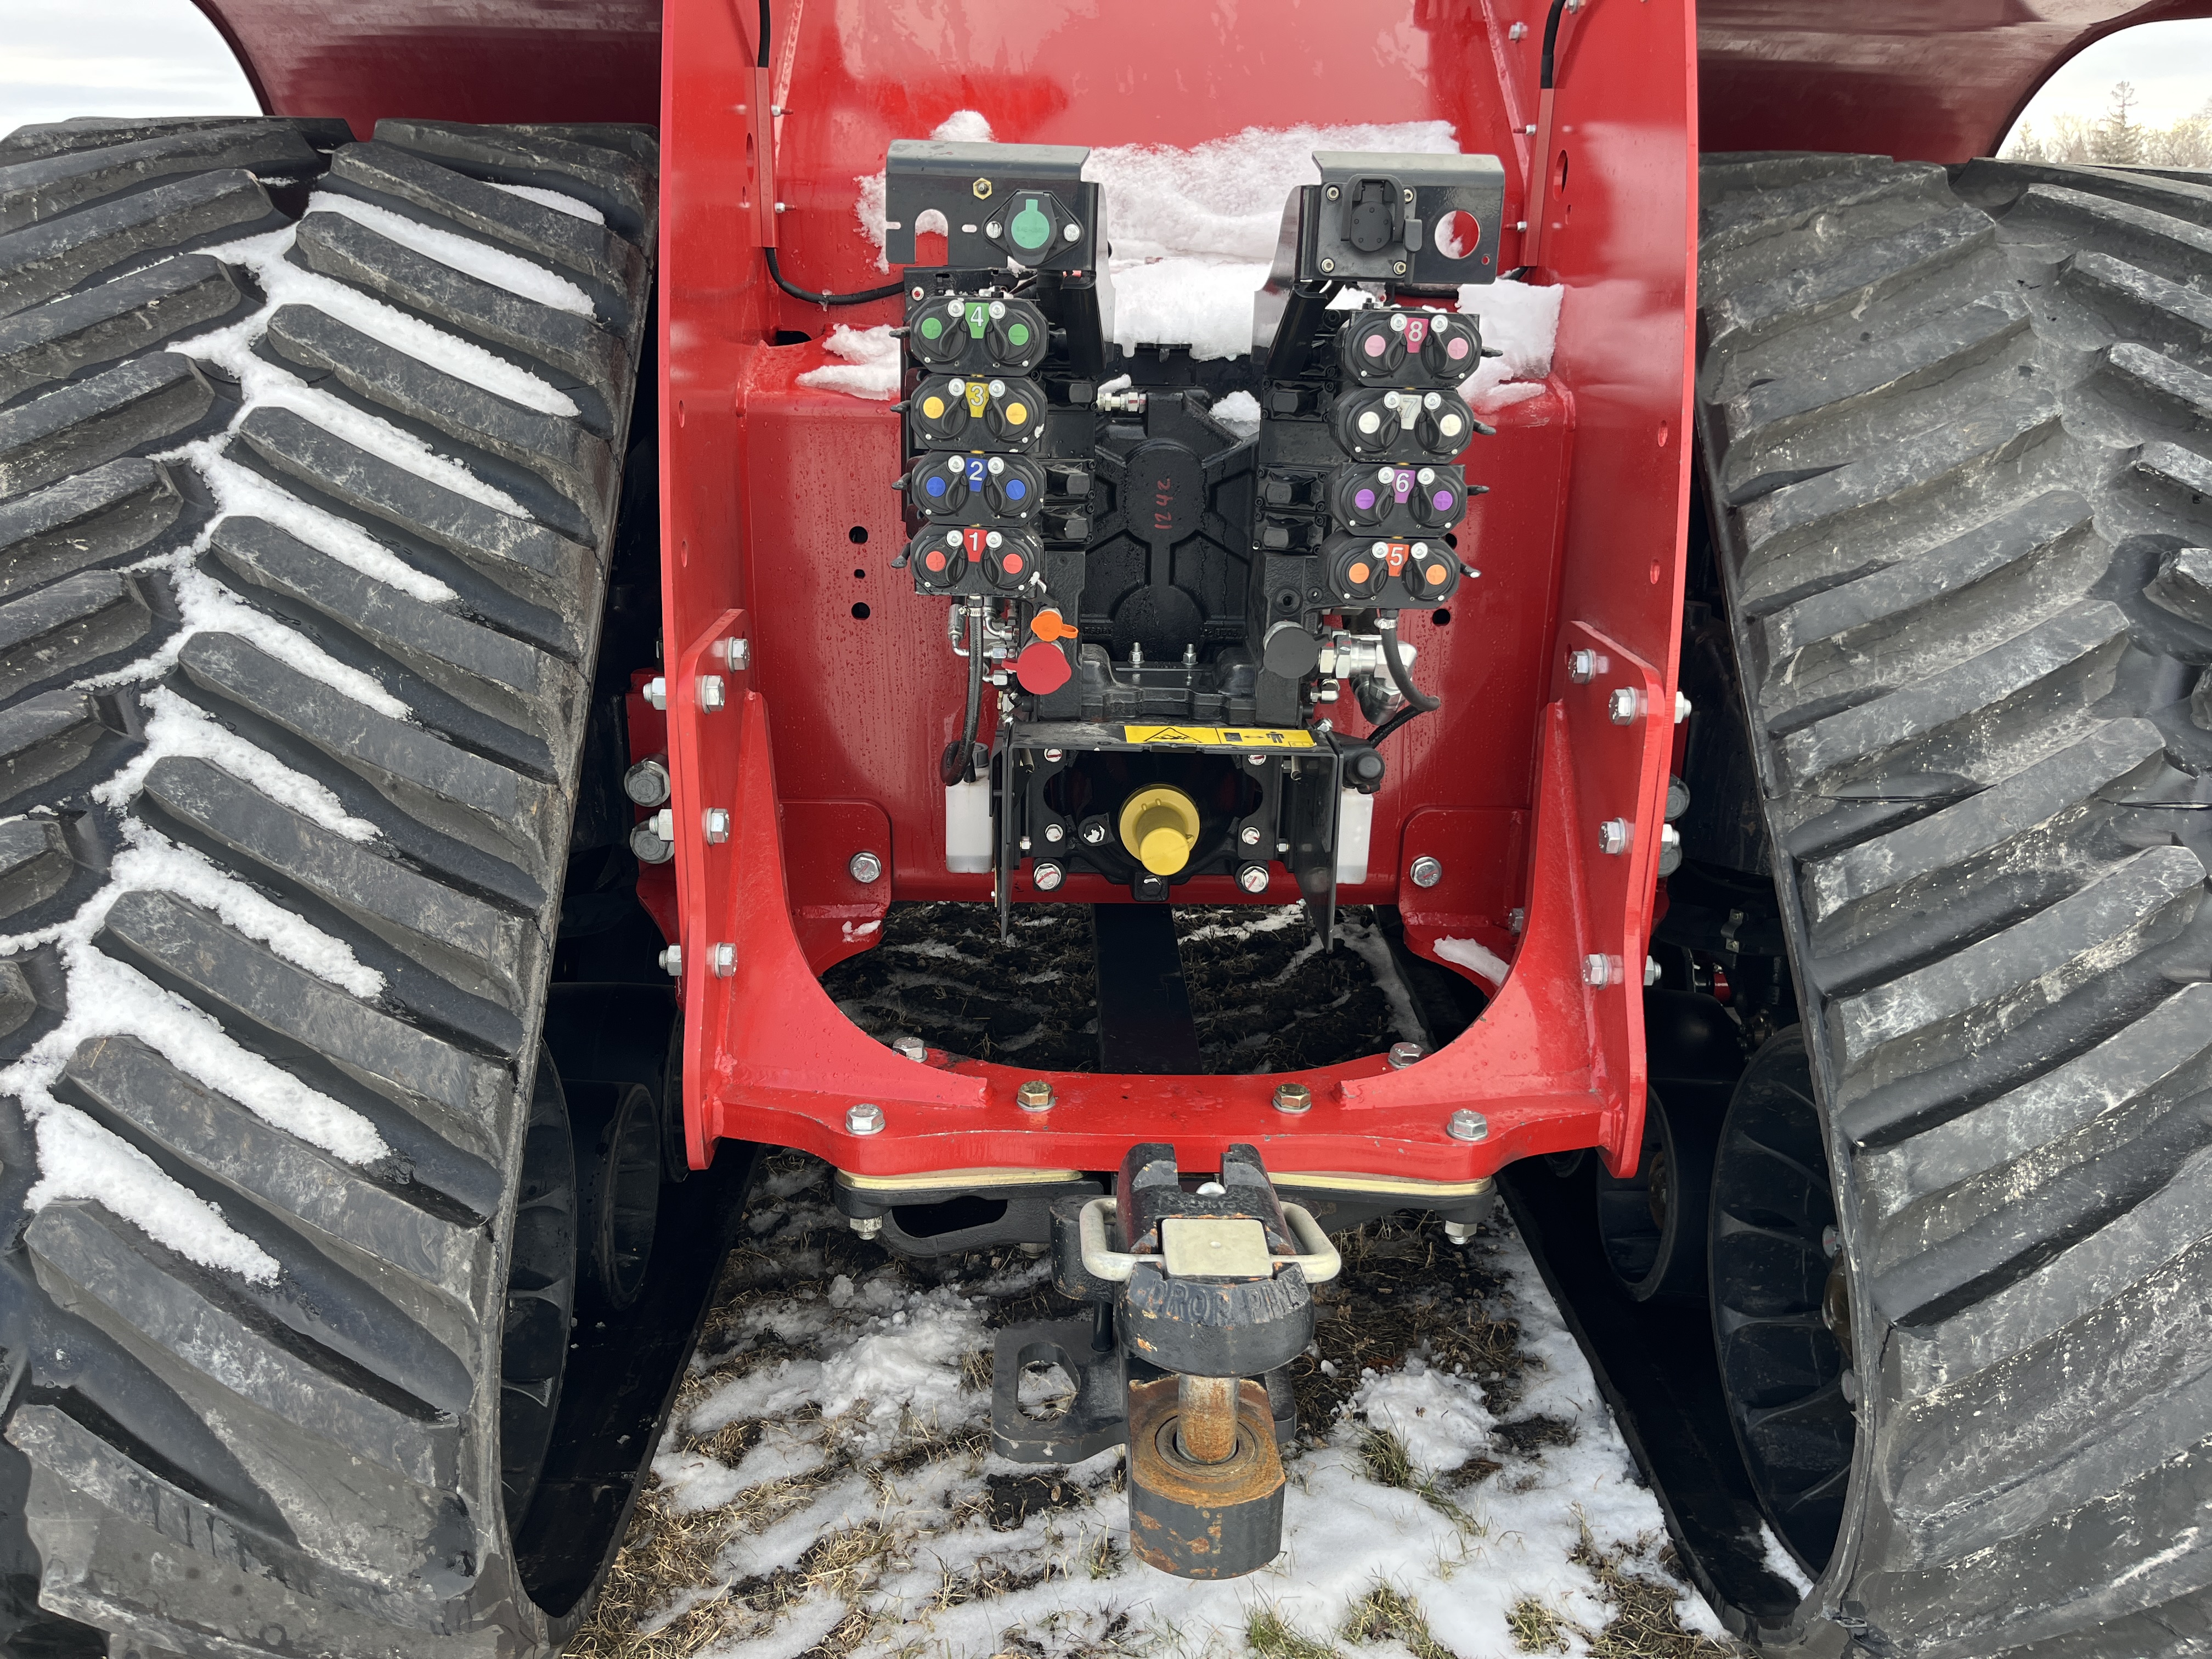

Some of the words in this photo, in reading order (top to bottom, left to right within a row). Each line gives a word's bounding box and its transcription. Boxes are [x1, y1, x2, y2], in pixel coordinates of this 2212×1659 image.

[970, 306, 984, 327] 4
[1408, 320, 1423, 342] 8
[970, 385, 984, 407] 3
[1402, 397, 1419, 419] 7
[969, 461, 983, 482] 2
[1395, 472, 1409, 493] 6
[969, 532, 978, 551] 1
[1389, 546, 1403, 566] 5
[1149, 1278, 1233, 1326] DROP
